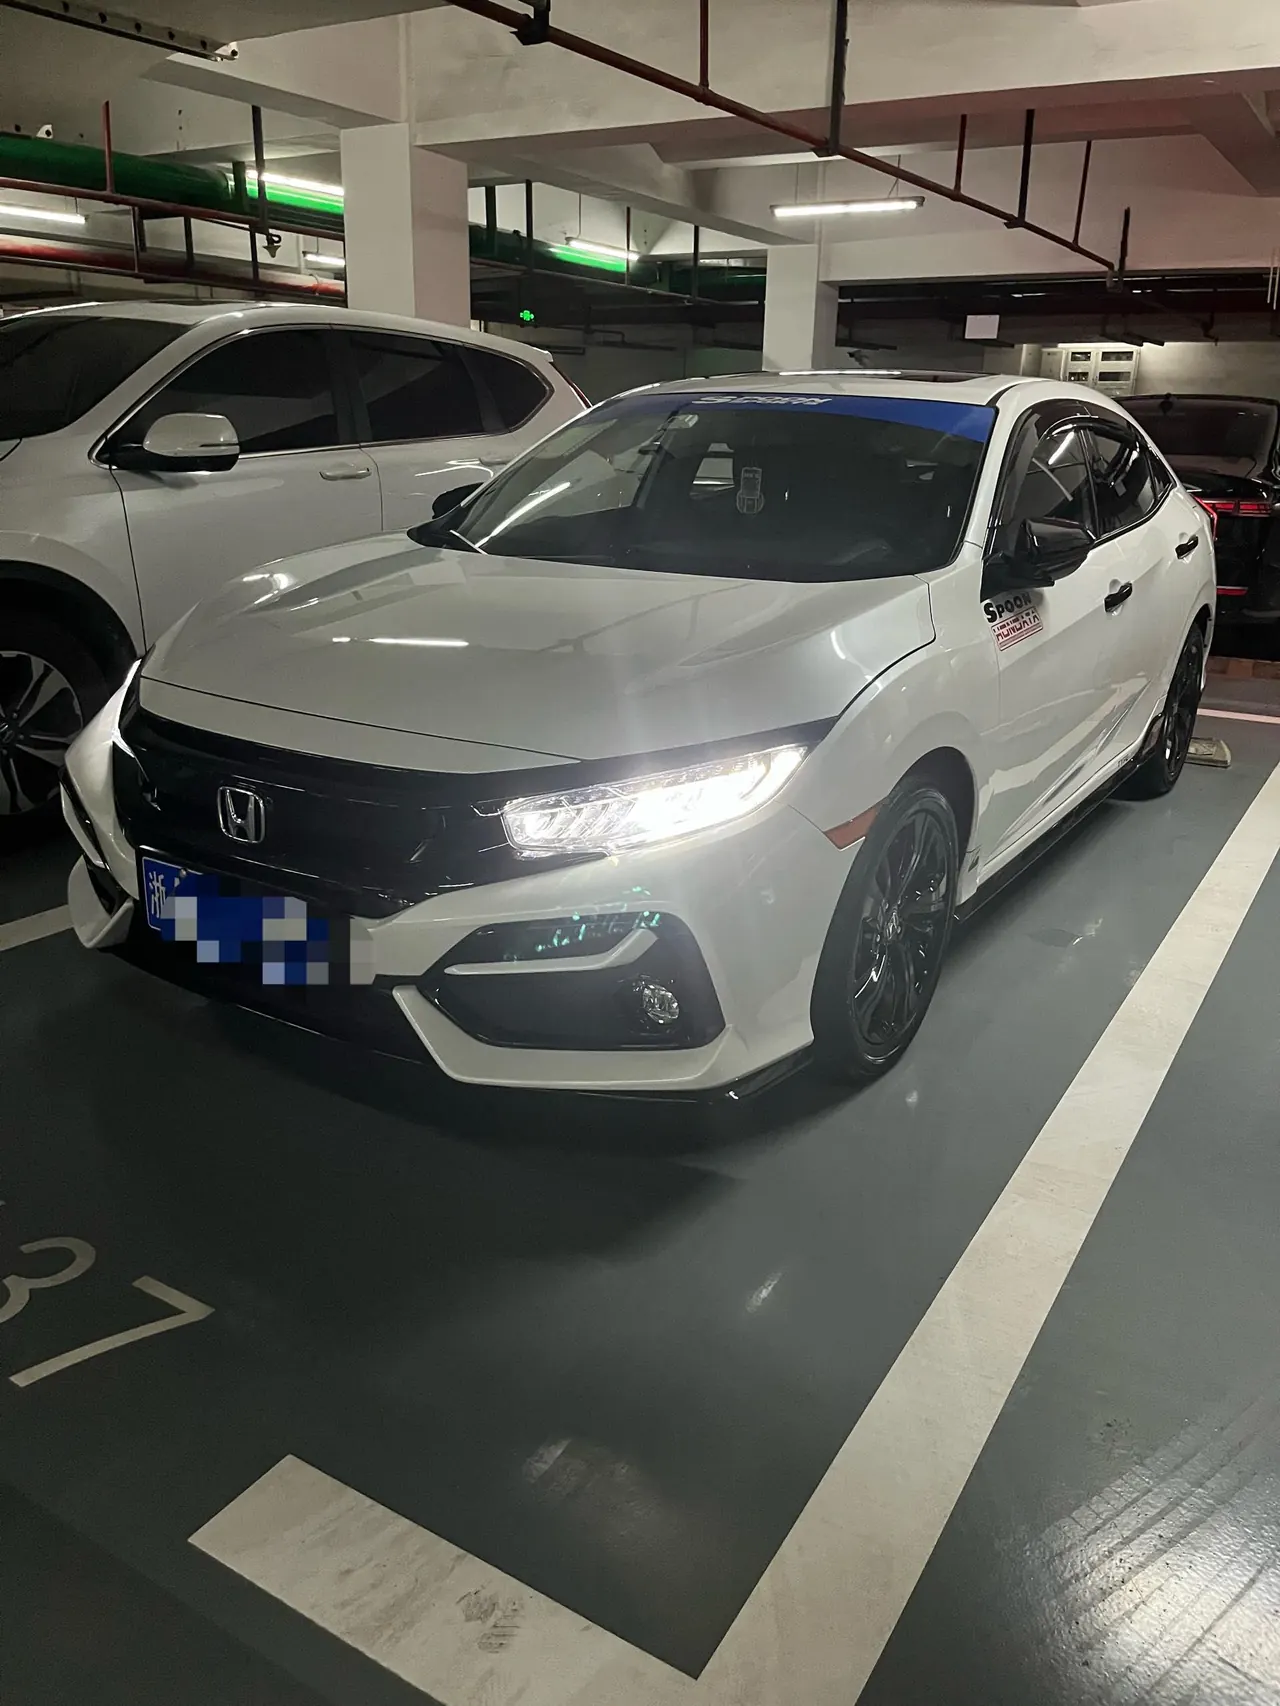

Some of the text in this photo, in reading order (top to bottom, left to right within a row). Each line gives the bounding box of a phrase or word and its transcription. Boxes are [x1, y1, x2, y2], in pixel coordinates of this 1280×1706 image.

[983, 592, 1032, 623] SPOON
[992, 608, 1041, 642] HONDATA
[0, 1200, 216, 1388] 37
